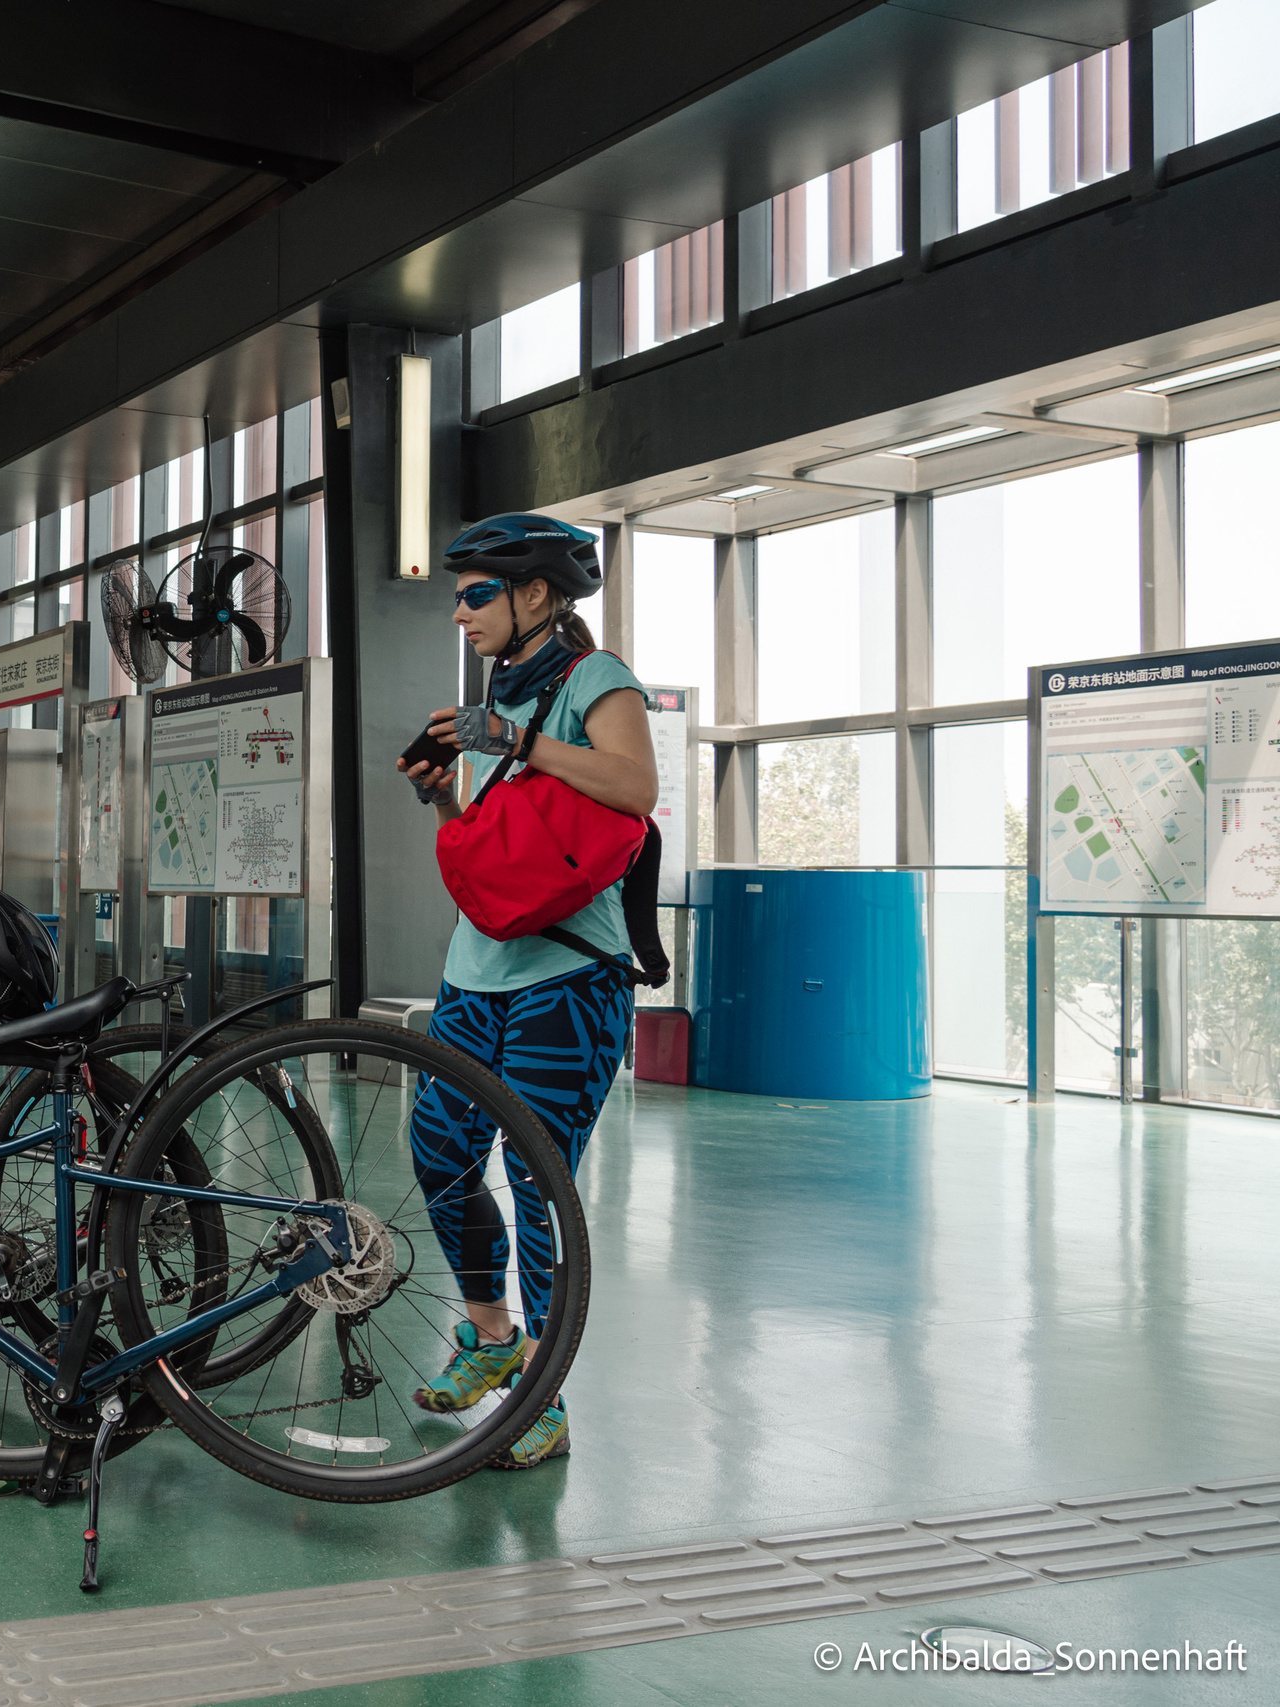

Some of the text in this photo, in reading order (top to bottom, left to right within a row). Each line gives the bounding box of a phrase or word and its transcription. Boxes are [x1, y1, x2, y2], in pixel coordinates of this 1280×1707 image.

[1068, 665, 1185, 689] 荣京东街站地面示意图
[1192, 668, 1208, 677] Map
